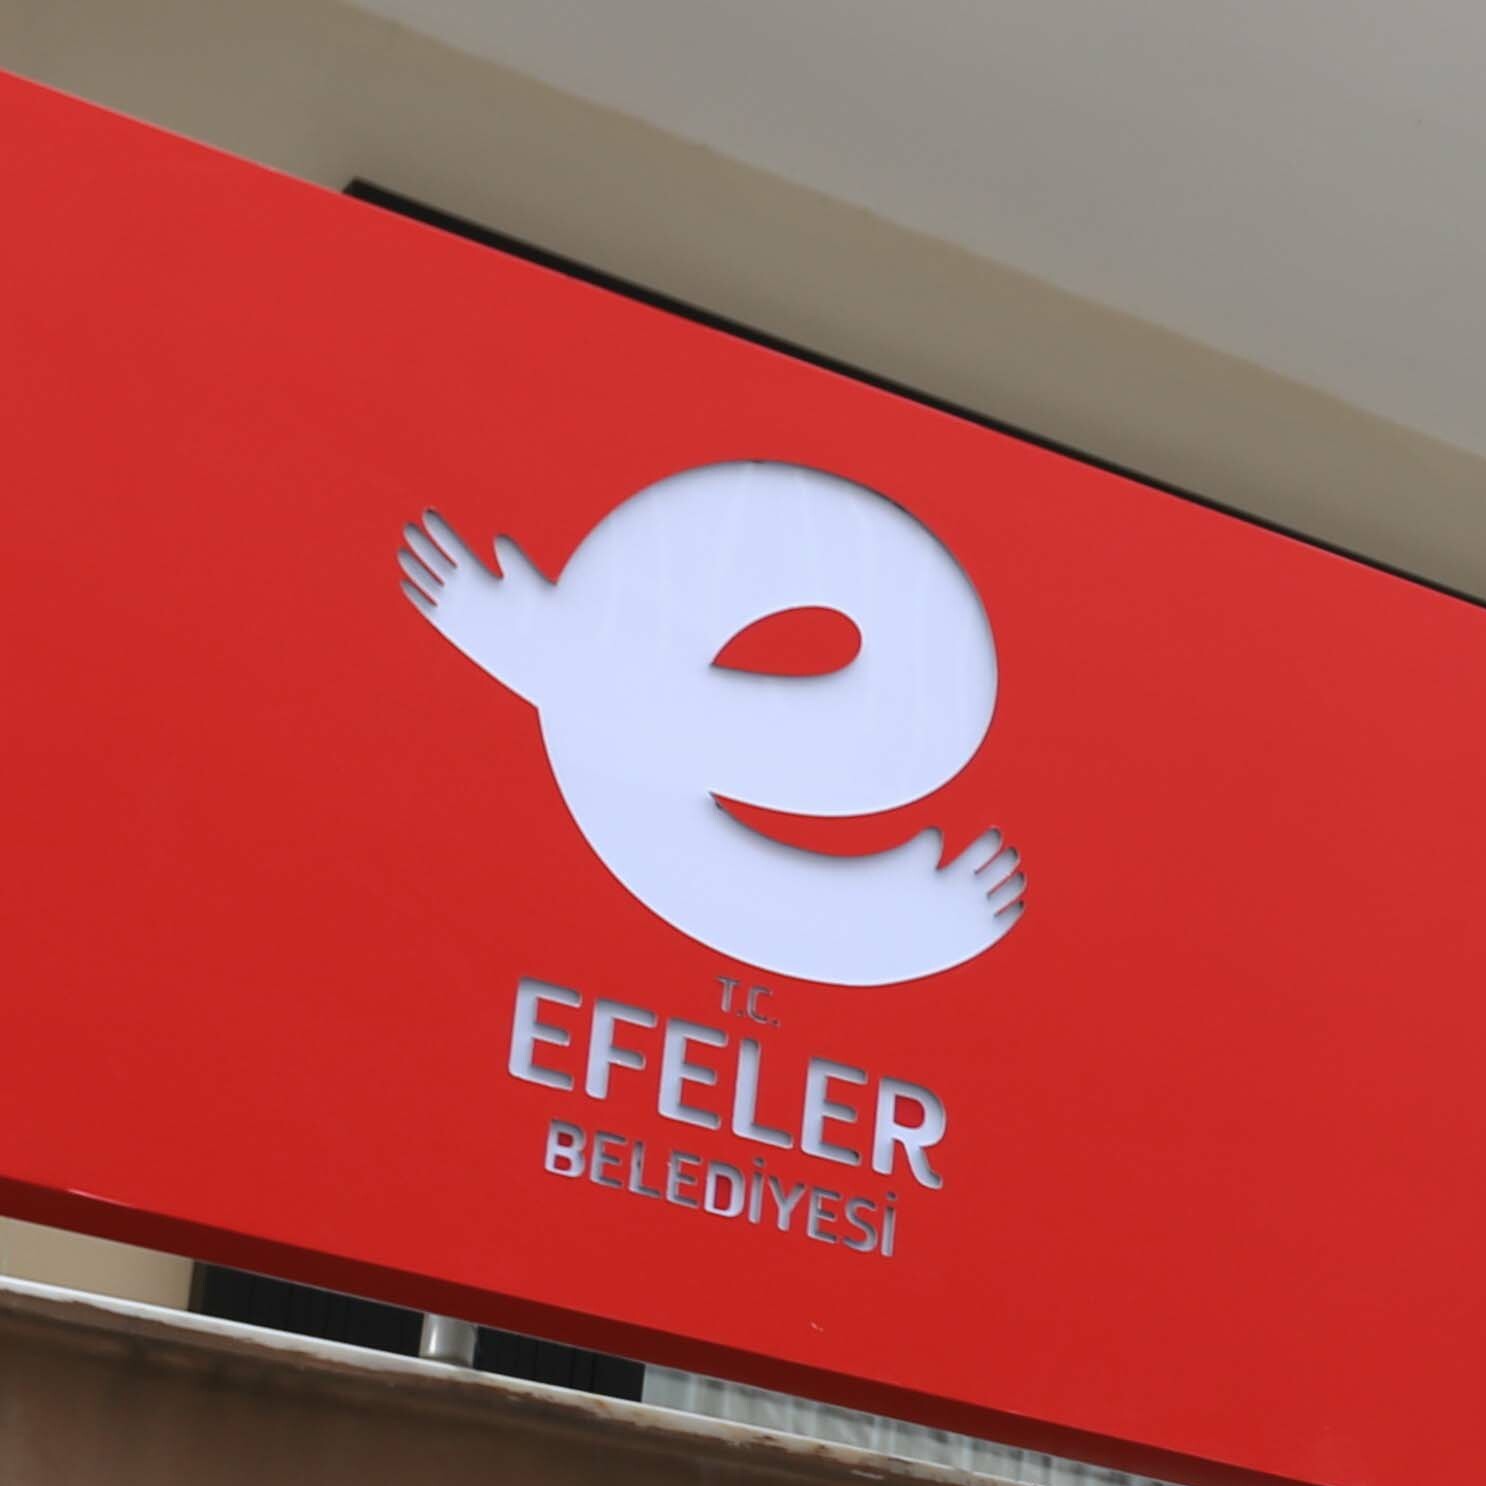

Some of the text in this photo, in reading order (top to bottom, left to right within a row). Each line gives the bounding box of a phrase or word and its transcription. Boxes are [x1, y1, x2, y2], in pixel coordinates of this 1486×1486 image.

[716, 976, 781, 1027] T.C.
[508, 975, 948, 1189] EFELER
[544, 1119, 897, 1257] BELEDİYESİ
